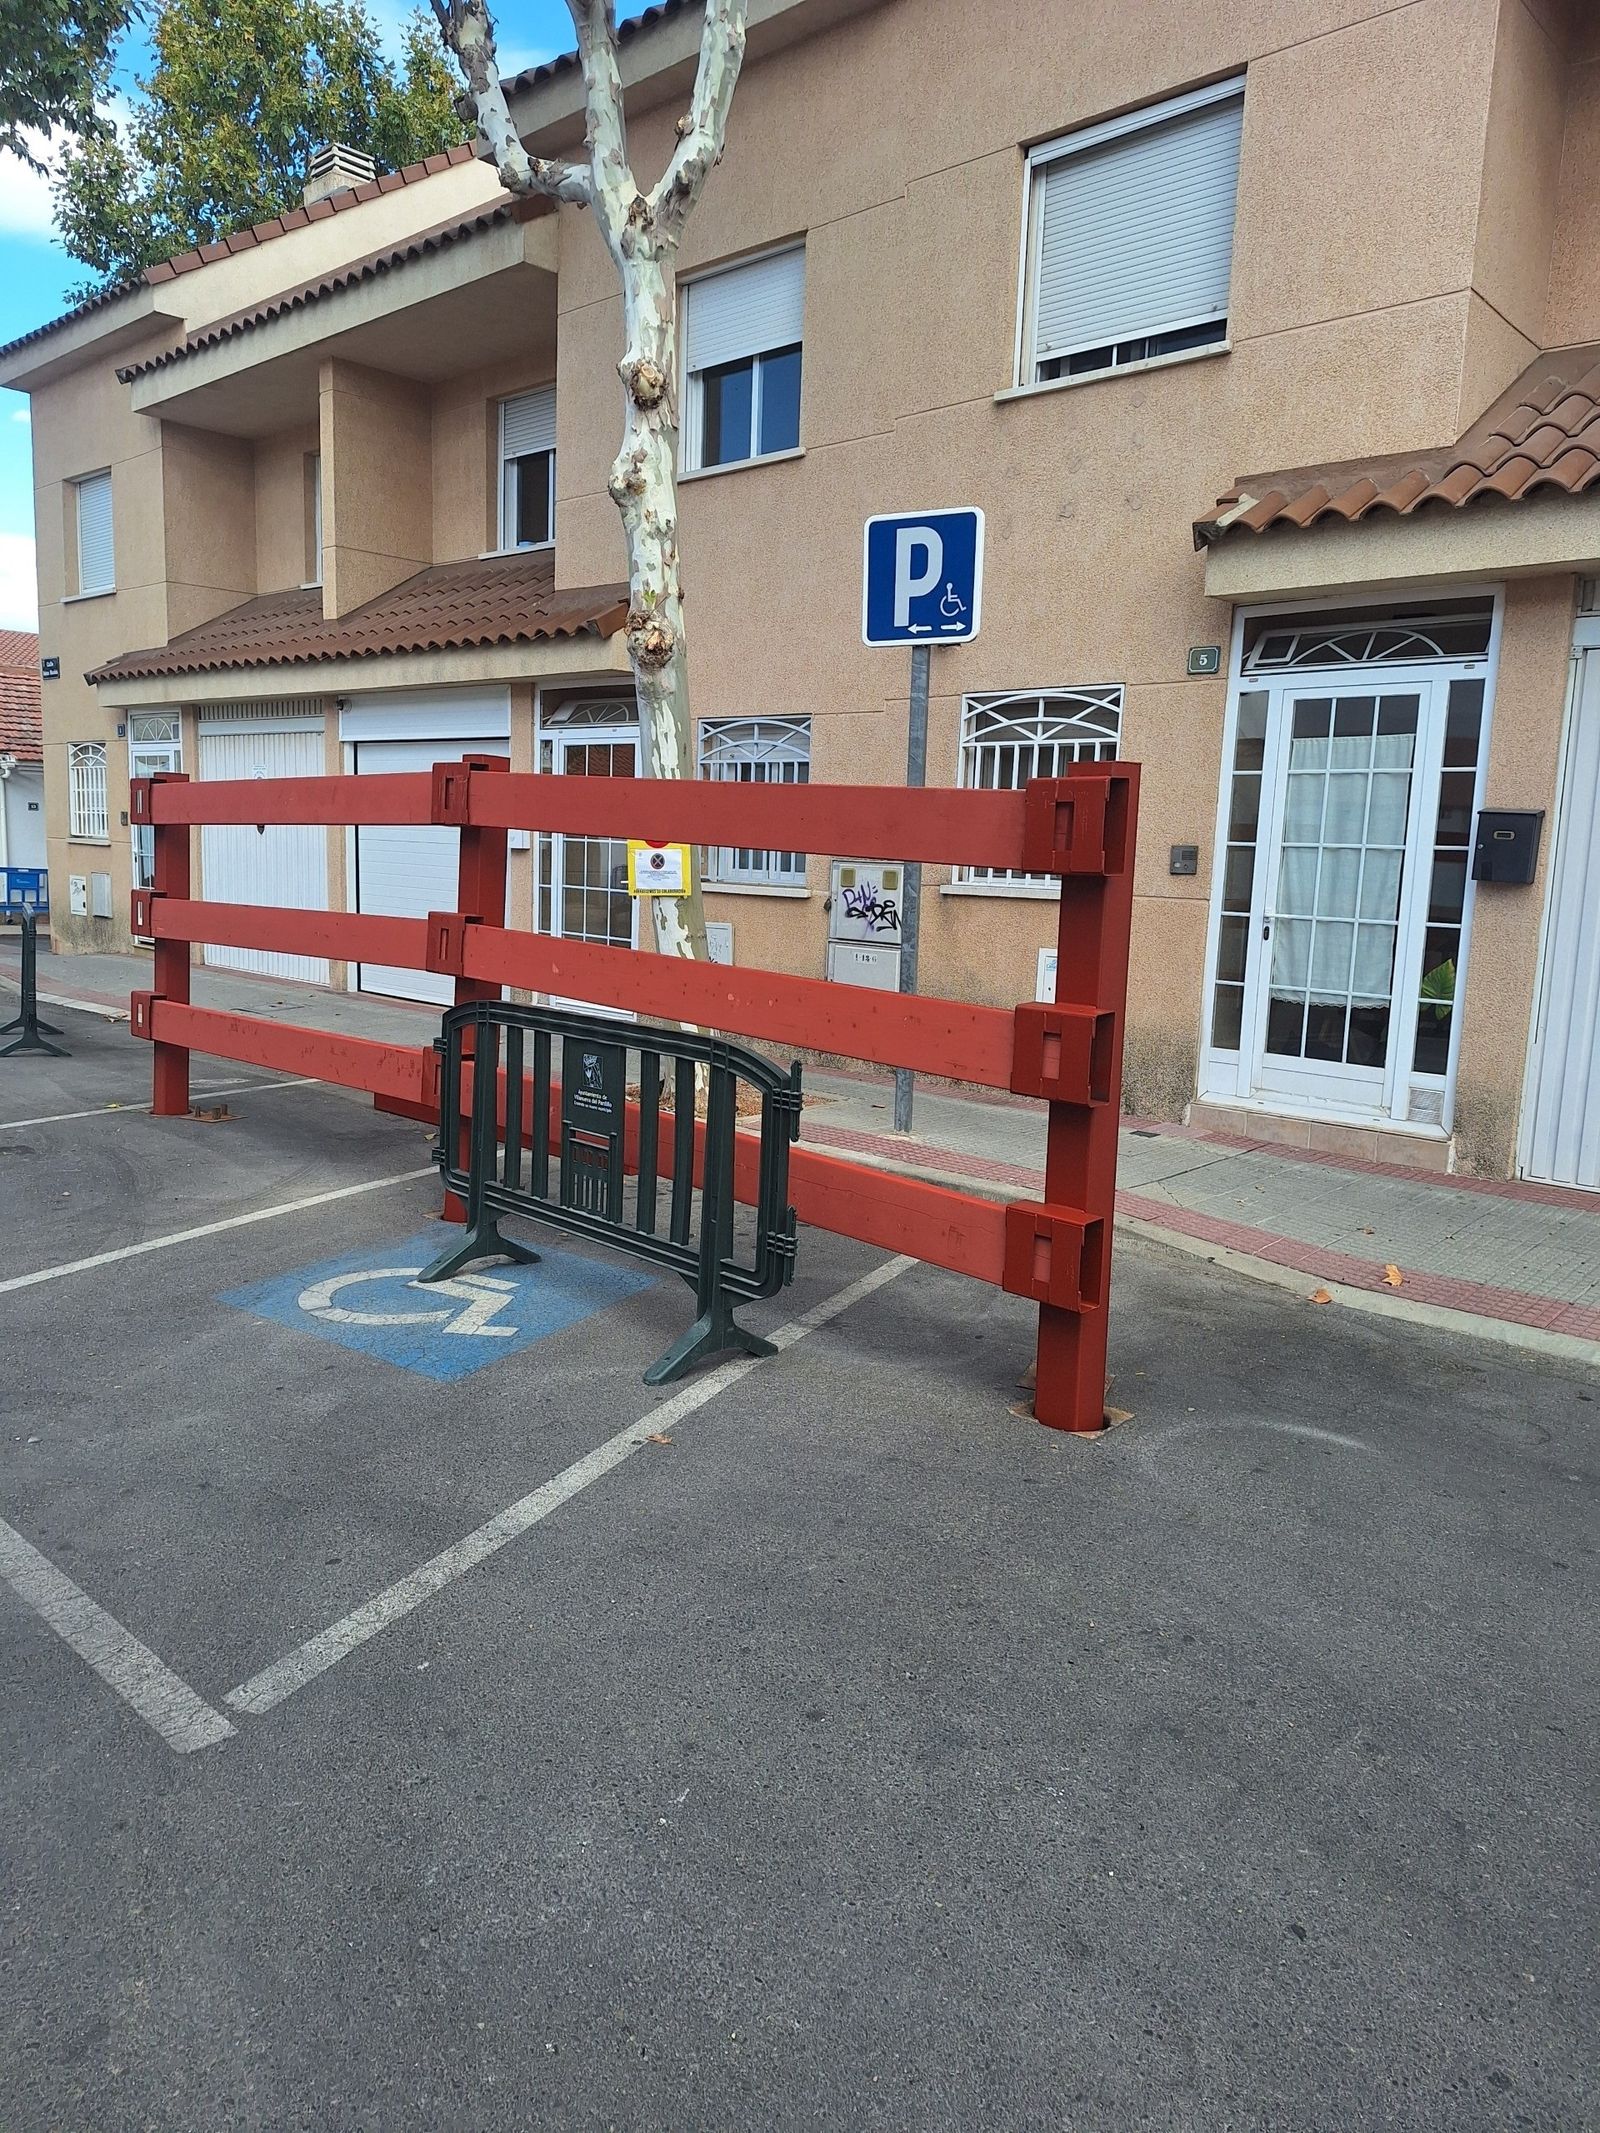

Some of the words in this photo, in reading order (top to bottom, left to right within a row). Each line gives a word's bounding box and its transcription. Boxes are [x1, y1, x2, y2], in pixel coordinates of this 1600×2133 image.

[893, 526, 943, 627] P
[1199, 654, 1208, 666] 5
[578, 1089, 601, 1099] Ayuntamiento
[574, 1094, 591, 1103] Villanueva
[598, 1099, 613, 1108] Pardillo
